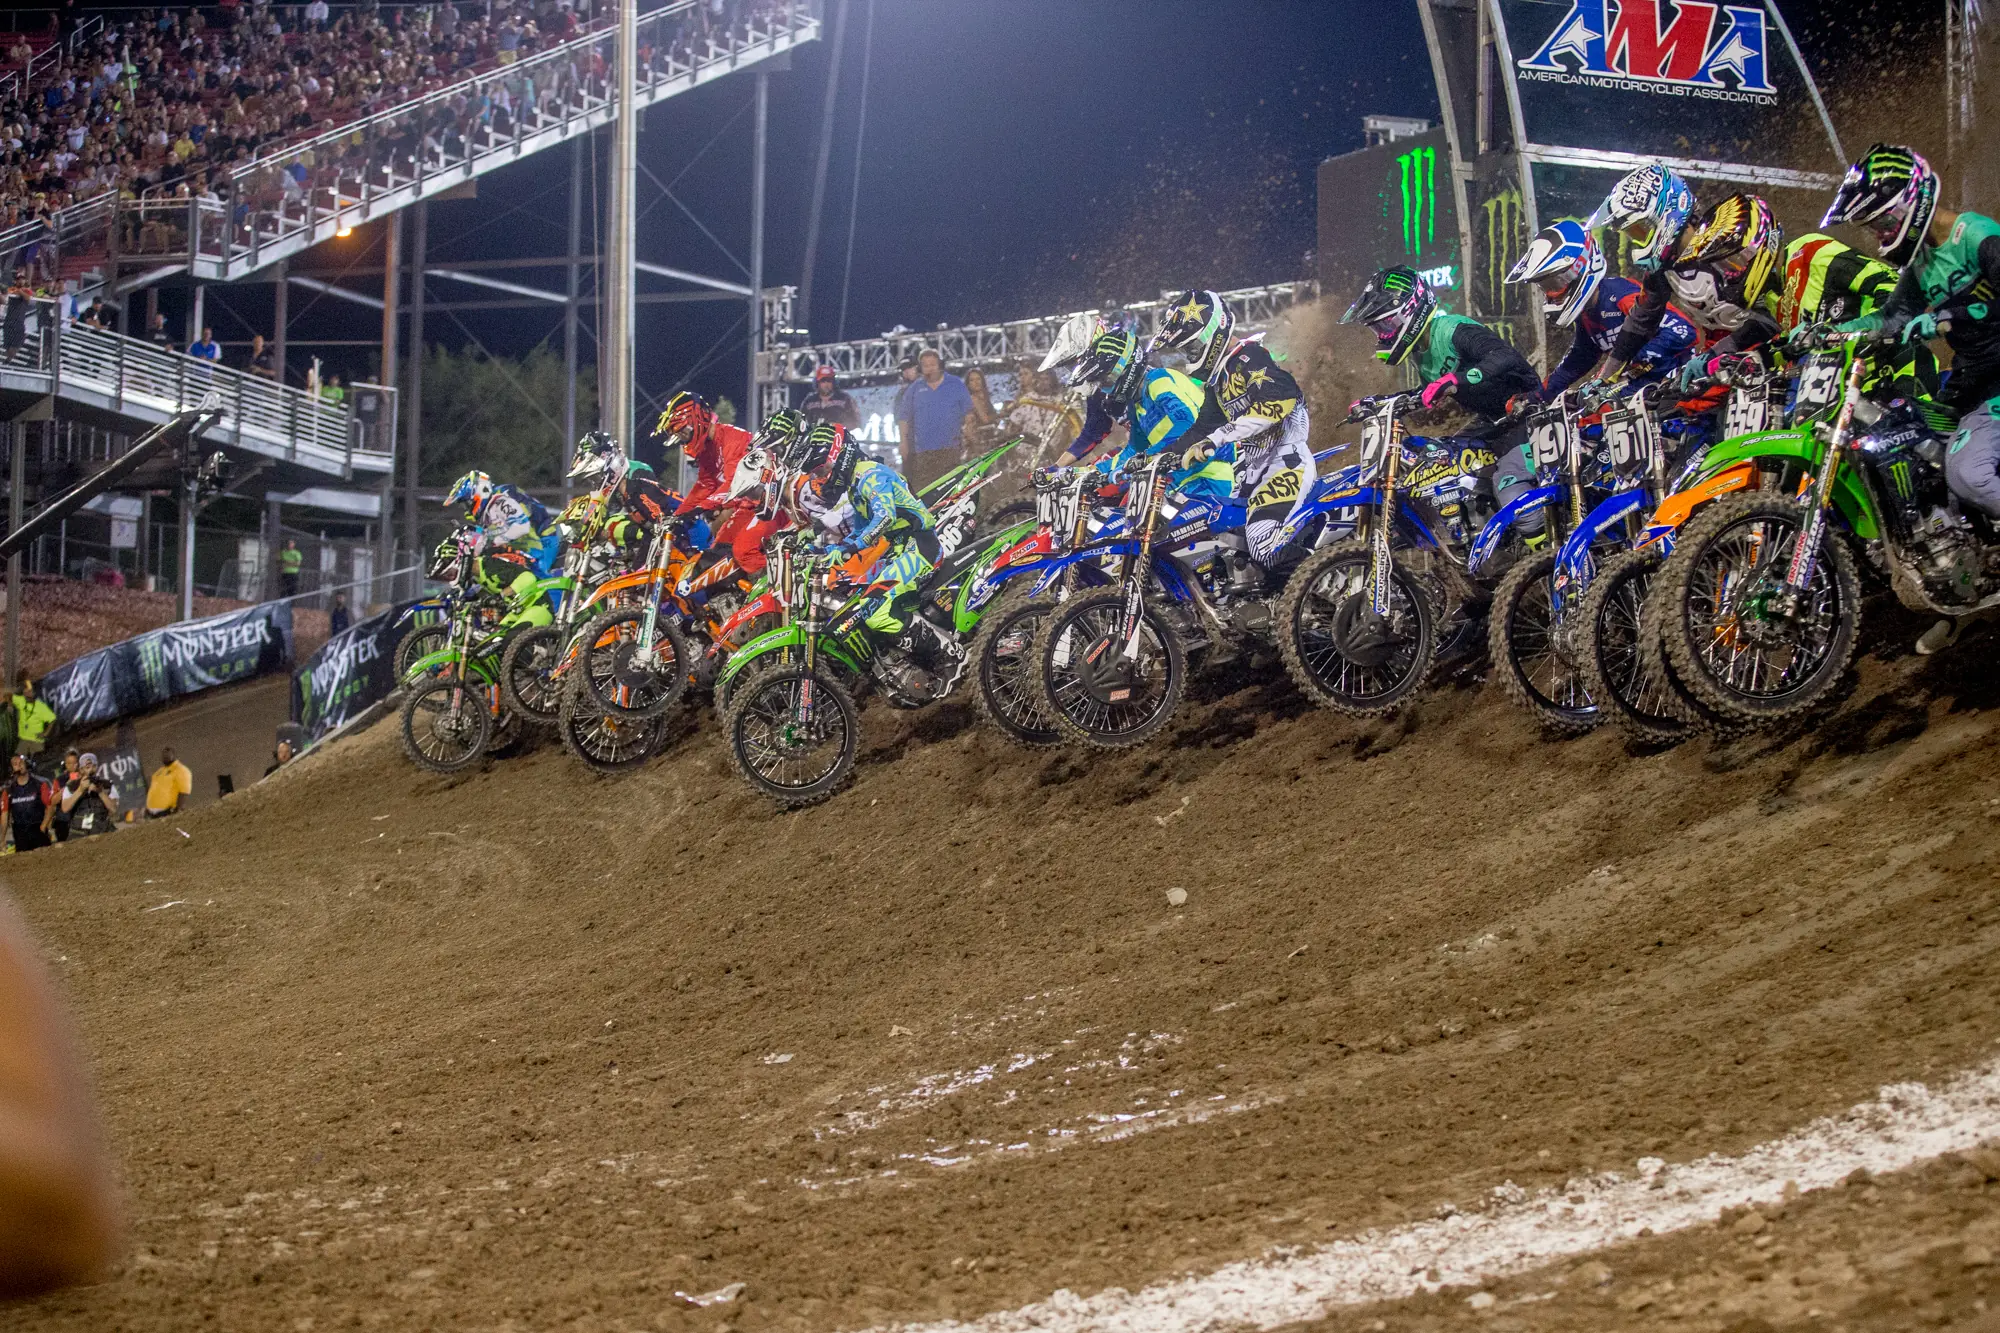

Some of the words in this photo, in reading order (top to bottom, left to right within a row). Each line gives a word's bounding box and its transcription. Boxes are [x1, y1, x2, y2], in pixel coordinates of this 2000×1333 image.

[1518, 0, 1778, 94] AMA
[1518, 70, 1590, 88] AMERICAN
[1590, 77, 1693, 98] MOTORCYCLIST
[1692, 86, 1779, 107] ASSOCIATION
[1724, 401, 1764, 440] 559
[1762, 433, 1804, 442] CIRCUIT
[1362, 425, 1380, 461] 7
[1530, 421, 1567, 468] 19
[1604, 418, 1647, 466] 151
[1179, 505, 1209, 522] YAMAHA
[937, 523, 963, 559] 86
[1009, 540, 1038, 561] AMSOIL
[1786, 531, 1809, 585] BRAKING
[162, 619, 271, 668] MONSTER
